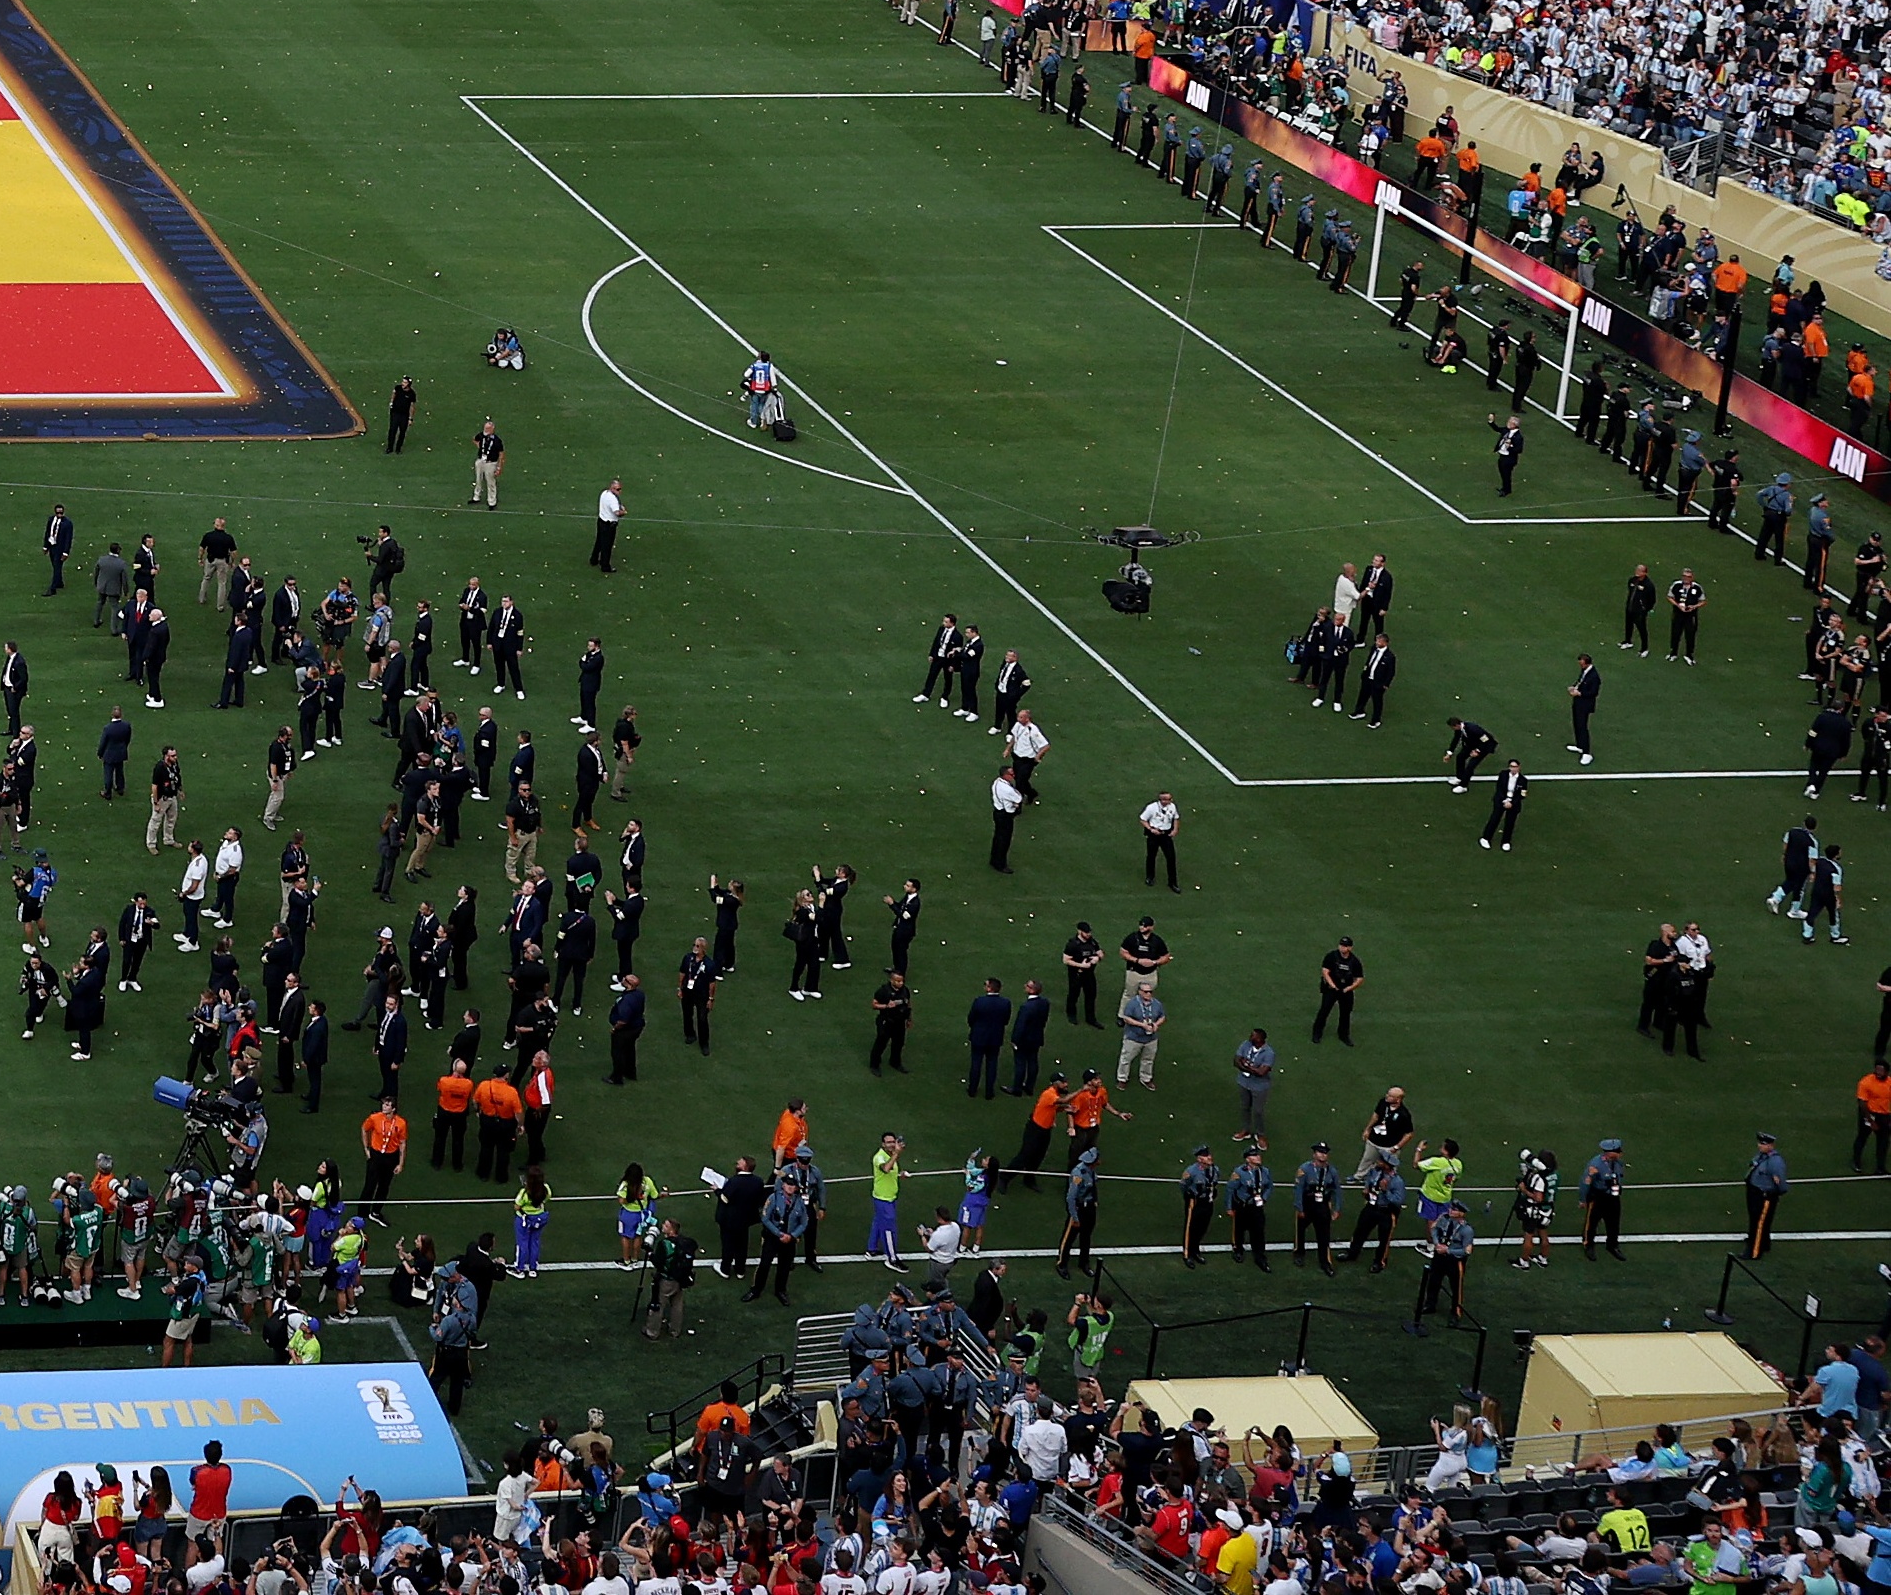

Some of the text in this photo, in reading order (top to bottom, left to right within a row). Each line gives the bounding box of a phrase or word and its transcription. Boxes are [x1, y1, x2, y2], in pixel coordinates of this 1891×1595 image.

[1345, 45, 1378, 78] FIFA
[1186, 80, 1210, 112] AIN
[1582, 298, 1612, 336] AIN
[1830, 438, 1867, 482] AIN
[378, 1431, 422, 1439] 2026
[1627, 1526, 1649, 1549] 12
